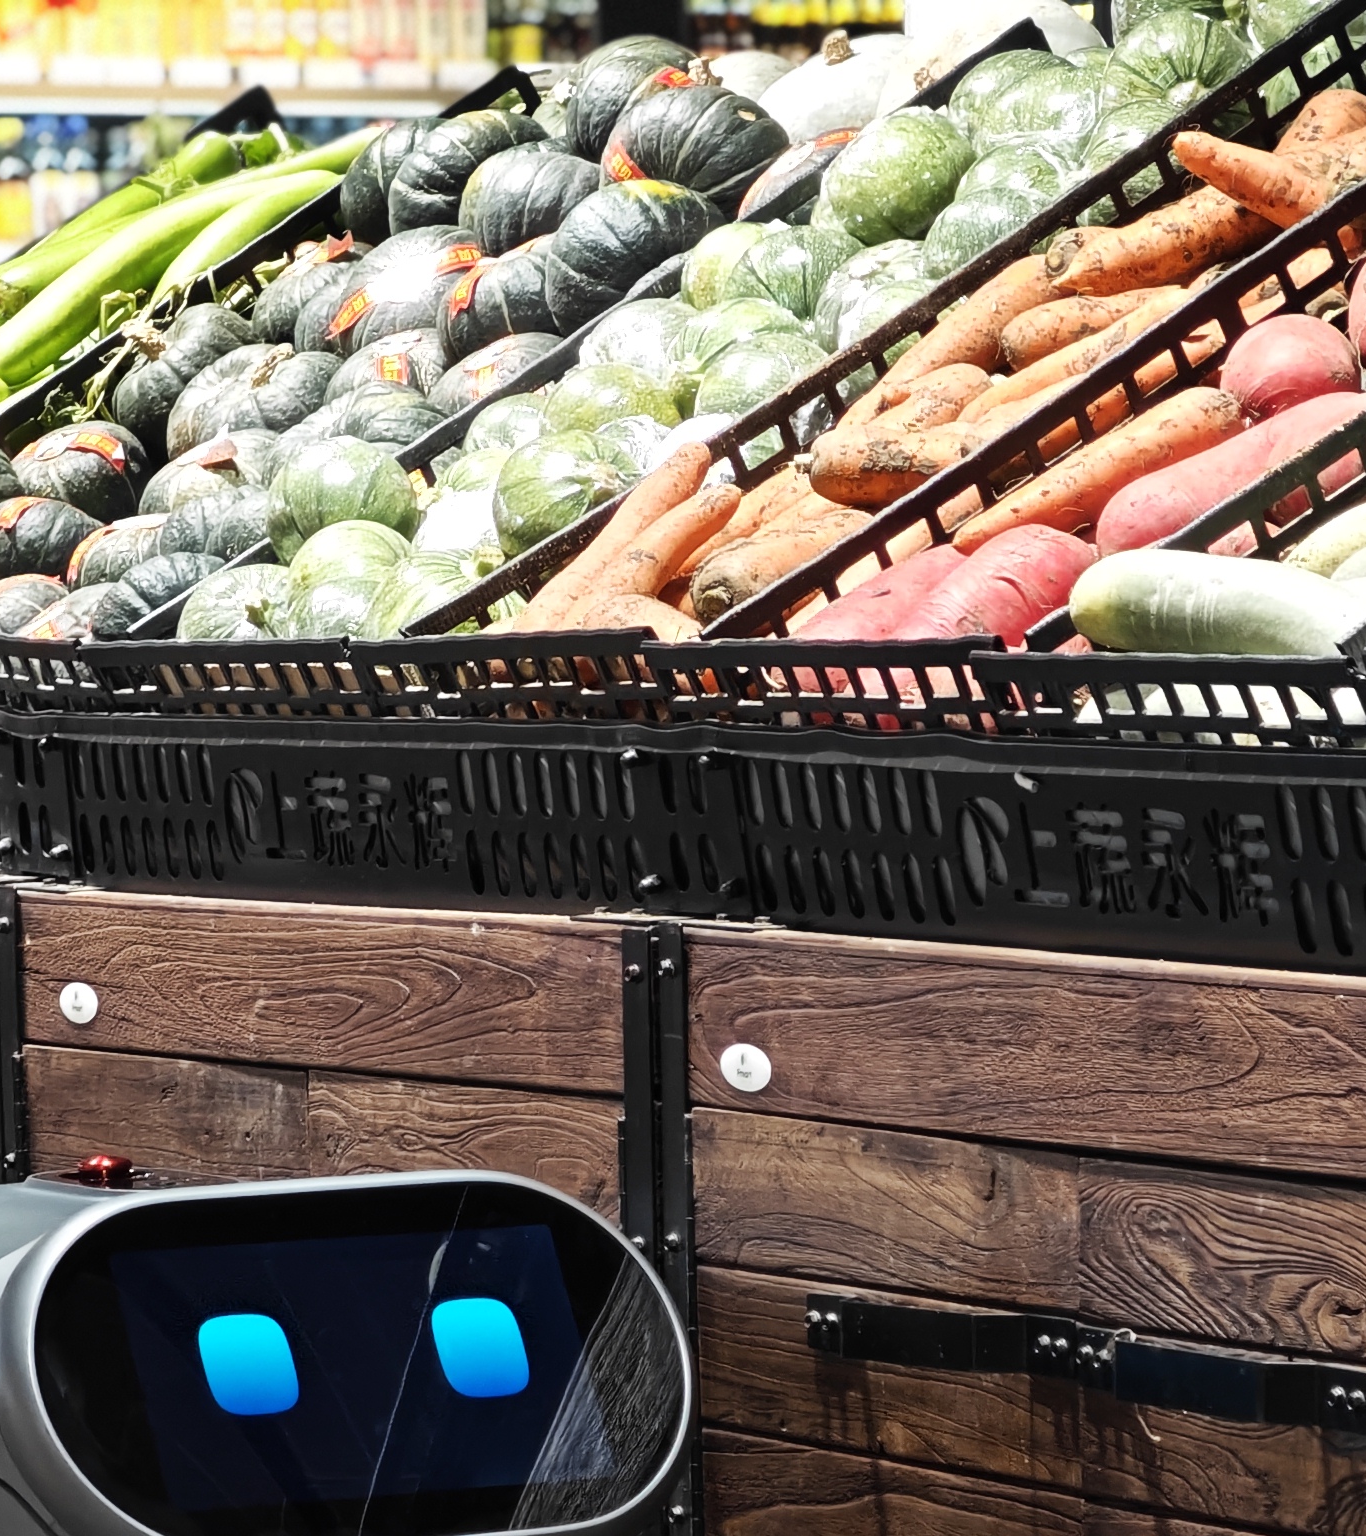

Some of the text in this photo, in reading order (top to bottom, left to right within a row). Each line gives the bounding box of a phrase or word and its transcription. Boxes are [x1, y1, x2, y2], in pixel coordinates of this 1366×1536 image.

[265, 769, 457, 875] 上蔬永辉
[1014, 801, 1280, 927] 上蔬永辉
